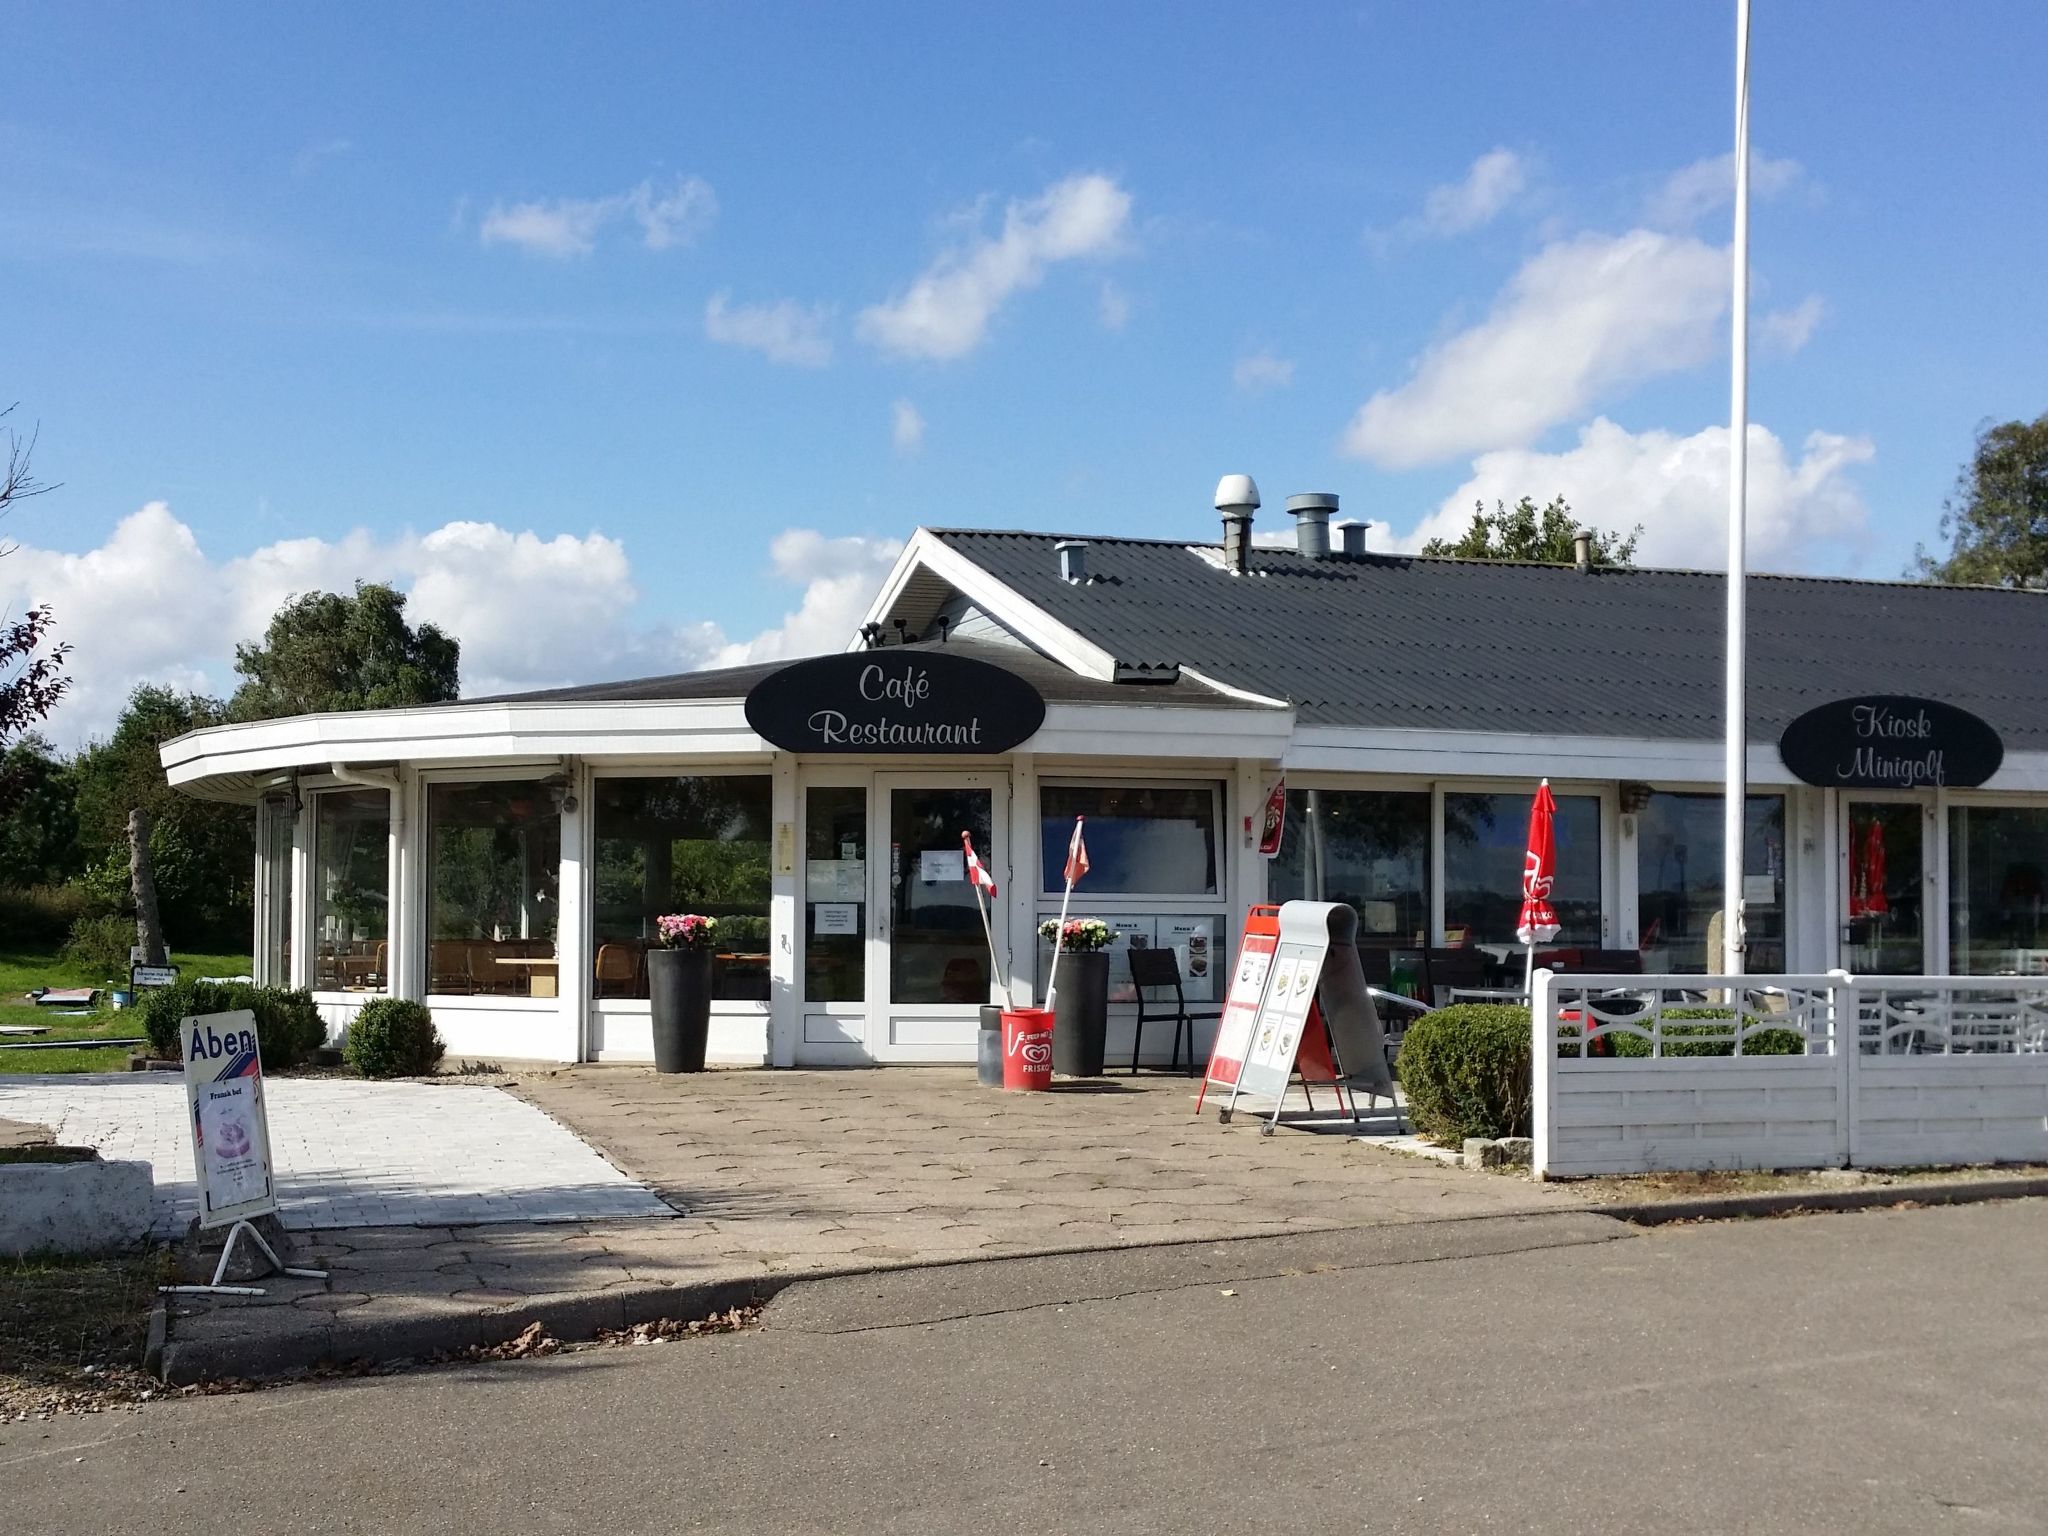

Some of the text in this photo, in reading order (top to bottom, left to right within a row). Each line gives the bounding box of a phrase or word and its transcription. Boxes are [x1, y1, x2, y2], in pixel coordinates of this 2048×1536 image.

[859, 664, 929, 708] Café
[808, 710, 981, 744] Restaurant
[1852, 705, 1932, 738] Kiosk
[1837, 747, 1945, 786] Minigolf
[190, 1019, 252, 1062] Åben
[1023, 1064, 1050, 1073] FRISKO
